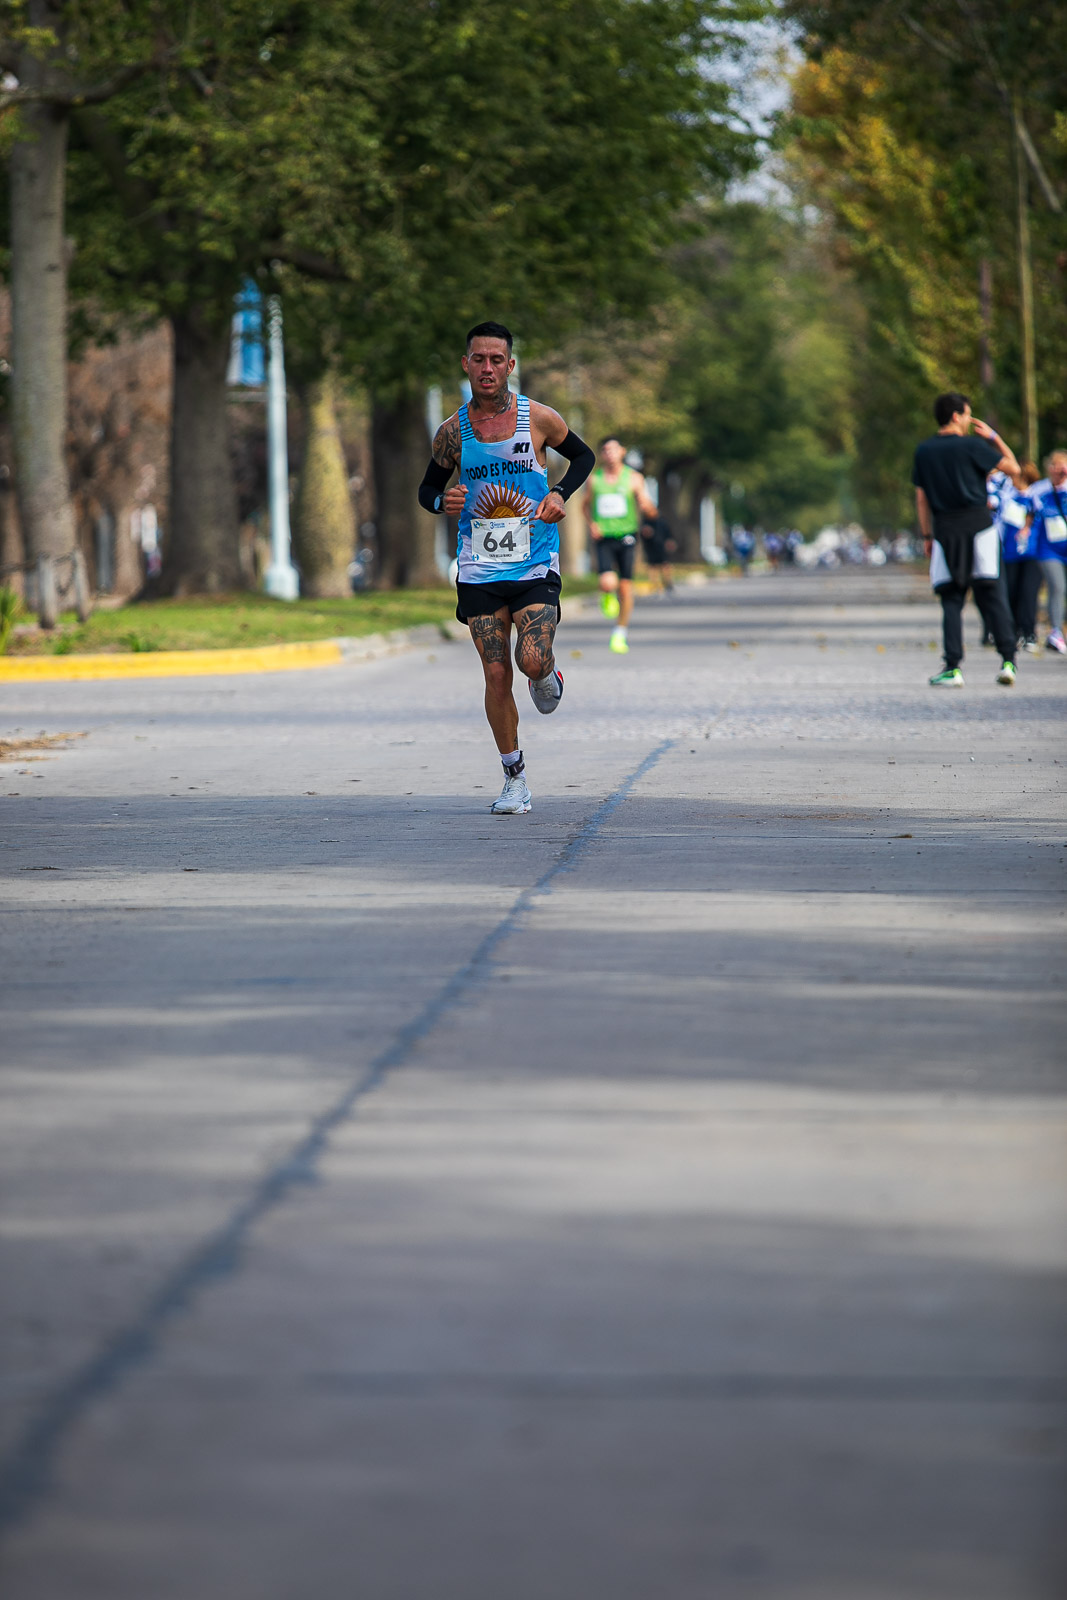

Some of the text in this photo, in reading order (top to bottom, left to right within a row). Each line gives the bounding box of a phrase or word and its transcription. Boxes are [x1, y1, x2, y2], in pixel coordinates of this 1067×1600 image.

[466, 458, 533, 480] TODO ES POSIBLE
[483, 530, 517, 552] 64
